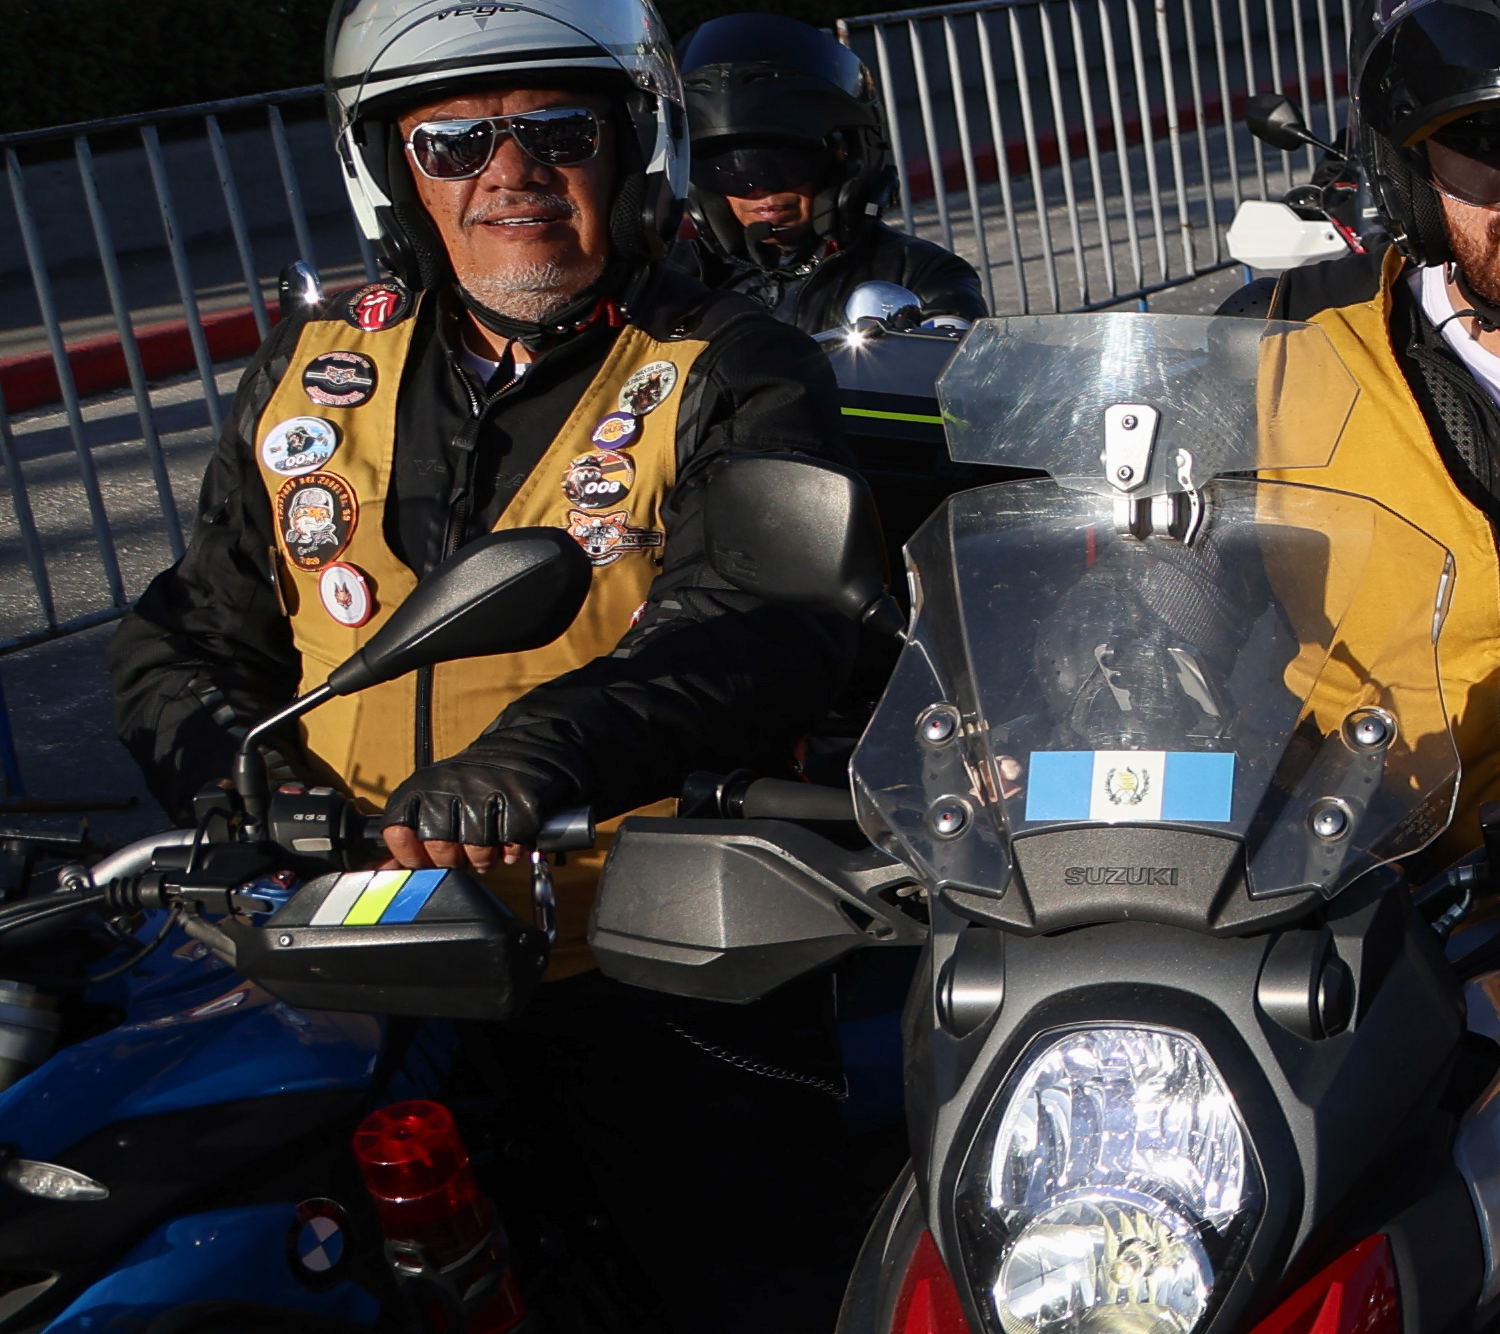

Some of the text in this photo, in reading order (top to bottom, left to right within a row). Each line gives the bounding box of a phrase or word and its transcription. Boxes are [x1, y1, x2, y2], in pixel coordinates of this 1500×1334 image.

[285, 453, 315, 467] 004
[584, 481, 621, 494] 008
[1066, 866, 1180, 886] SUZUKI
